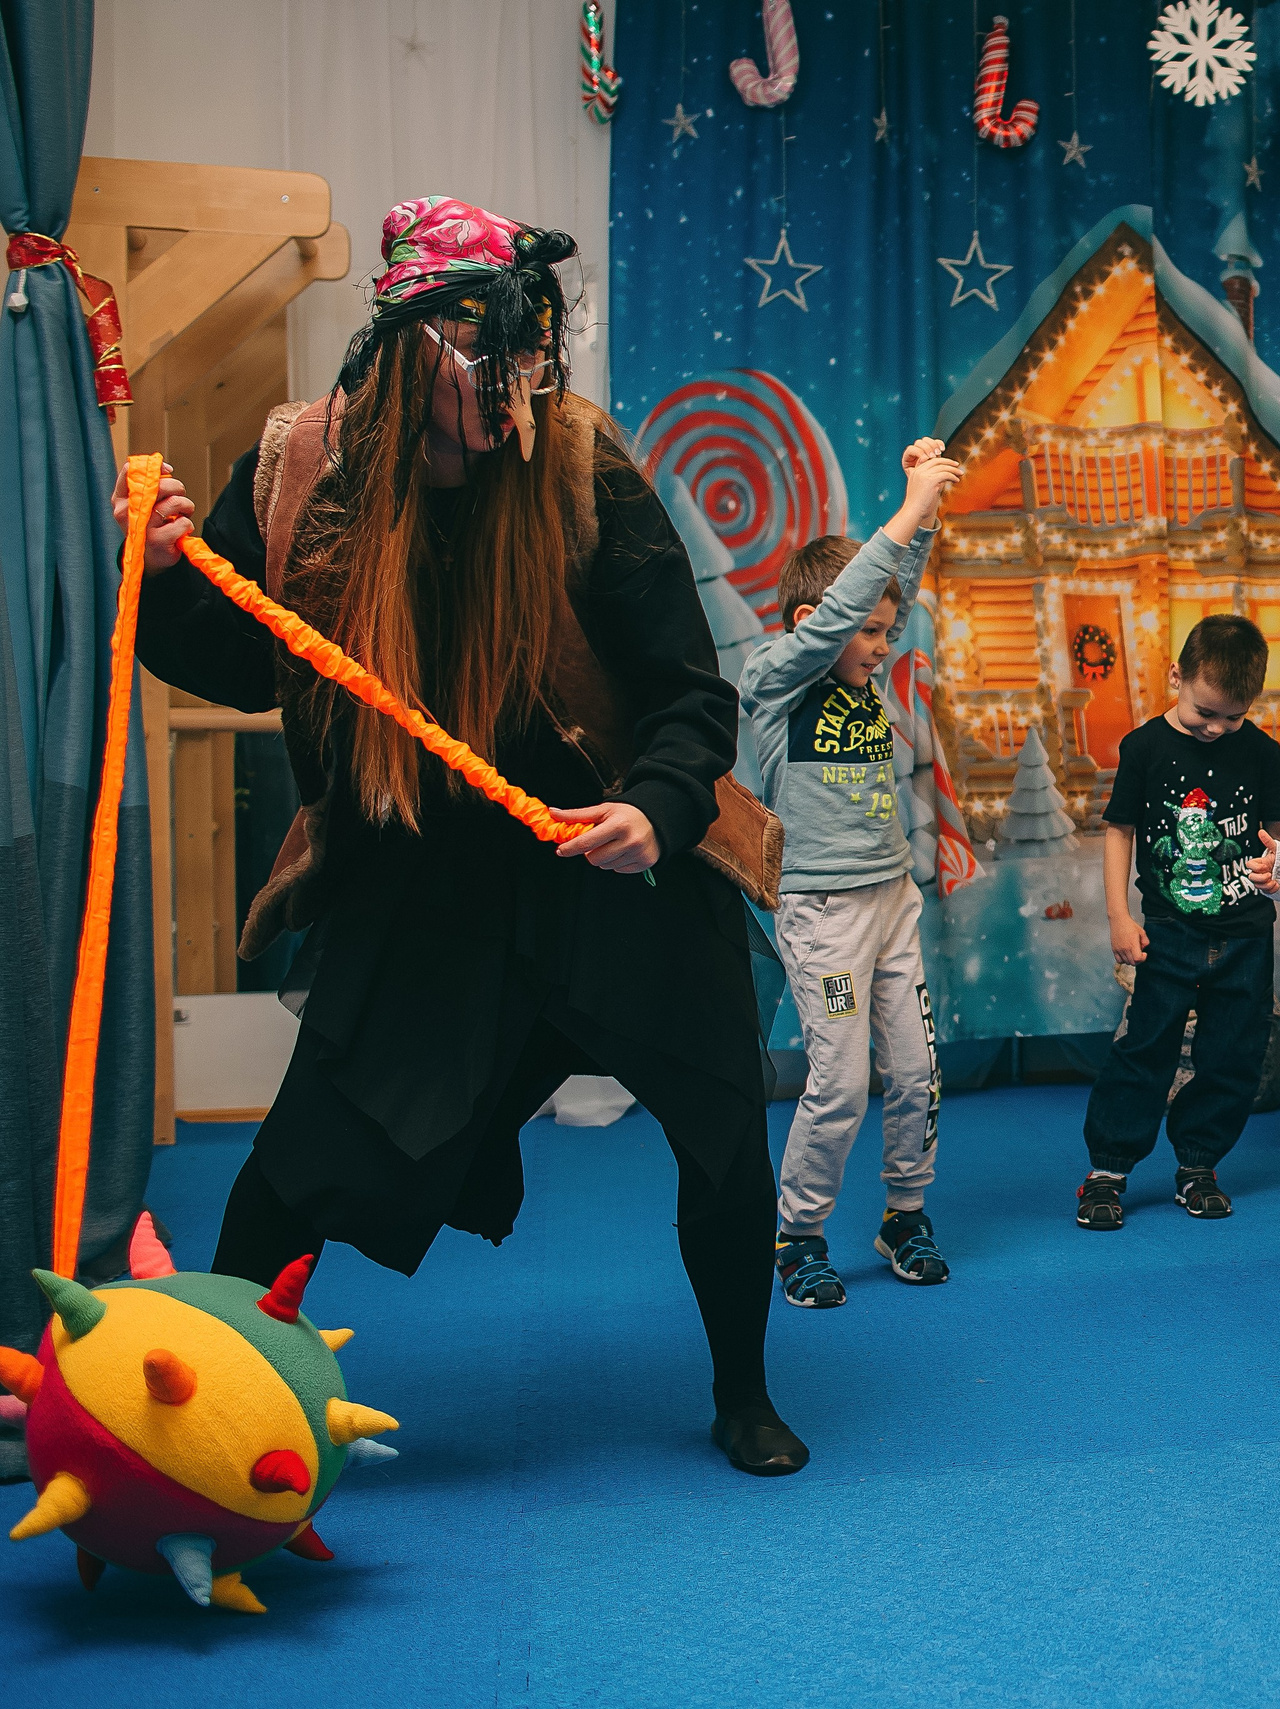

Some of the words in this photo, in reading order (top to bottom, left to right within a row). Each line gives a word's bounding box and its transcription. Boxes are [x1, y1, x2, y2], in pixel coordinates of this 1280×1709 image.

[822, 766, 867, 784] NEW
[1217, 812, 1248, 838] THIS
[1222, 864, 1231, 885] IS
[1222, 875, 1258, 906] YEA
